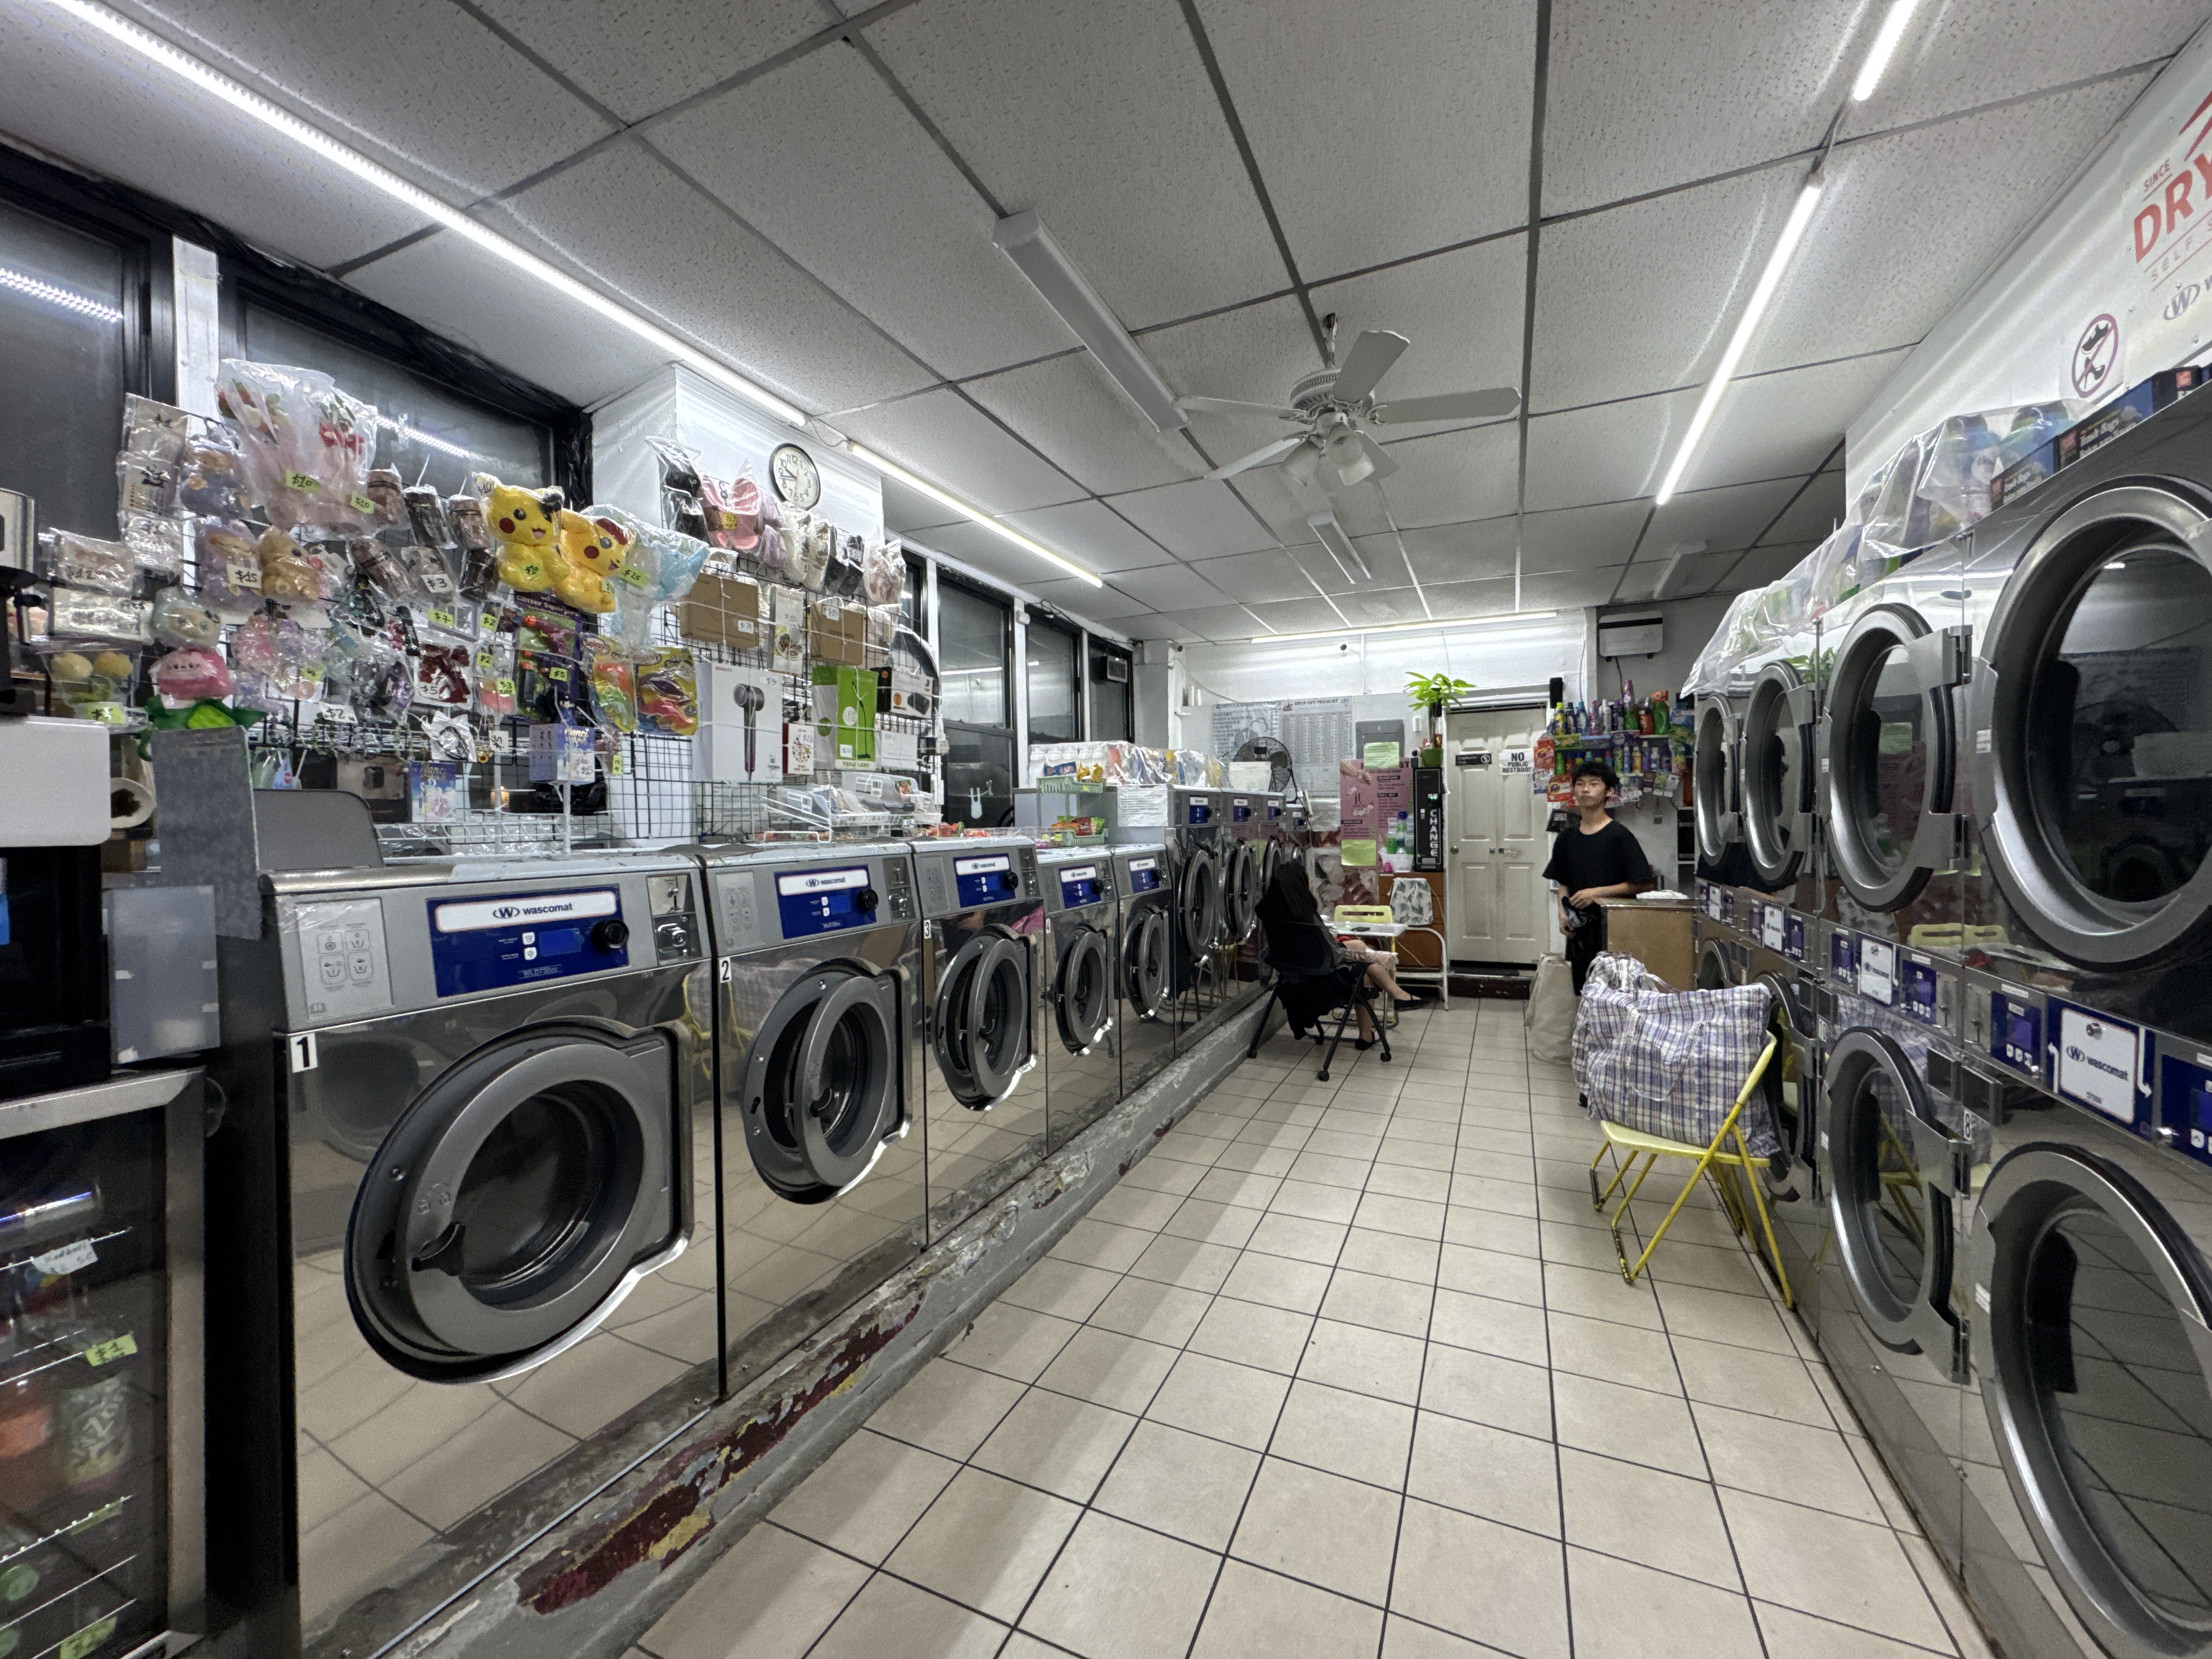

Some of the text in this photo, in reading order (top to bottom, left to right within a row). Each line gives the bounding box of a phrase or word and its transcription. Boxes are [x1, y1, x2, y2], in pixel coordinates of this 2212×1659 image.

[2144, 159, 2170, 192] SINCE
[2151, 236, 2193, 281] SELF
[292, 473, 312, 488] $10
[355, 497, 370, 509] $10
[525, 565, 539, 575] $10
[715, 563, 729, 572] $20
[235, 571, 257, 584] $15
[623, 569, 641, 581] $25
[427, 579, 447, 590] $3
[434, 613, 451, 624] $7
[484, 617, 495, 626] $2
[584, 638, 608, 652] Splash
[479, 656, 490, 664] $2
[421, 686, 438, 695] $5
[499, 681, 512, 690] $3
[327, 707, 346, 718] $2
[1511, 752, 1524, 761] NO
[581, 766, 594, 775] $15
[1430, 809, 1438, 857] CHANGE
[820, 877, 846, 885] wascomat
[523, 902, 573, 915] wascomat
[925, 922, 930, 938] 3
[721, 961, 730, 981] 2
[296, 1038, 311, 1067] 1
[2086, 1056, 2129, 1081] wascomat
[1965, 1114, 1971, 1139] 8
